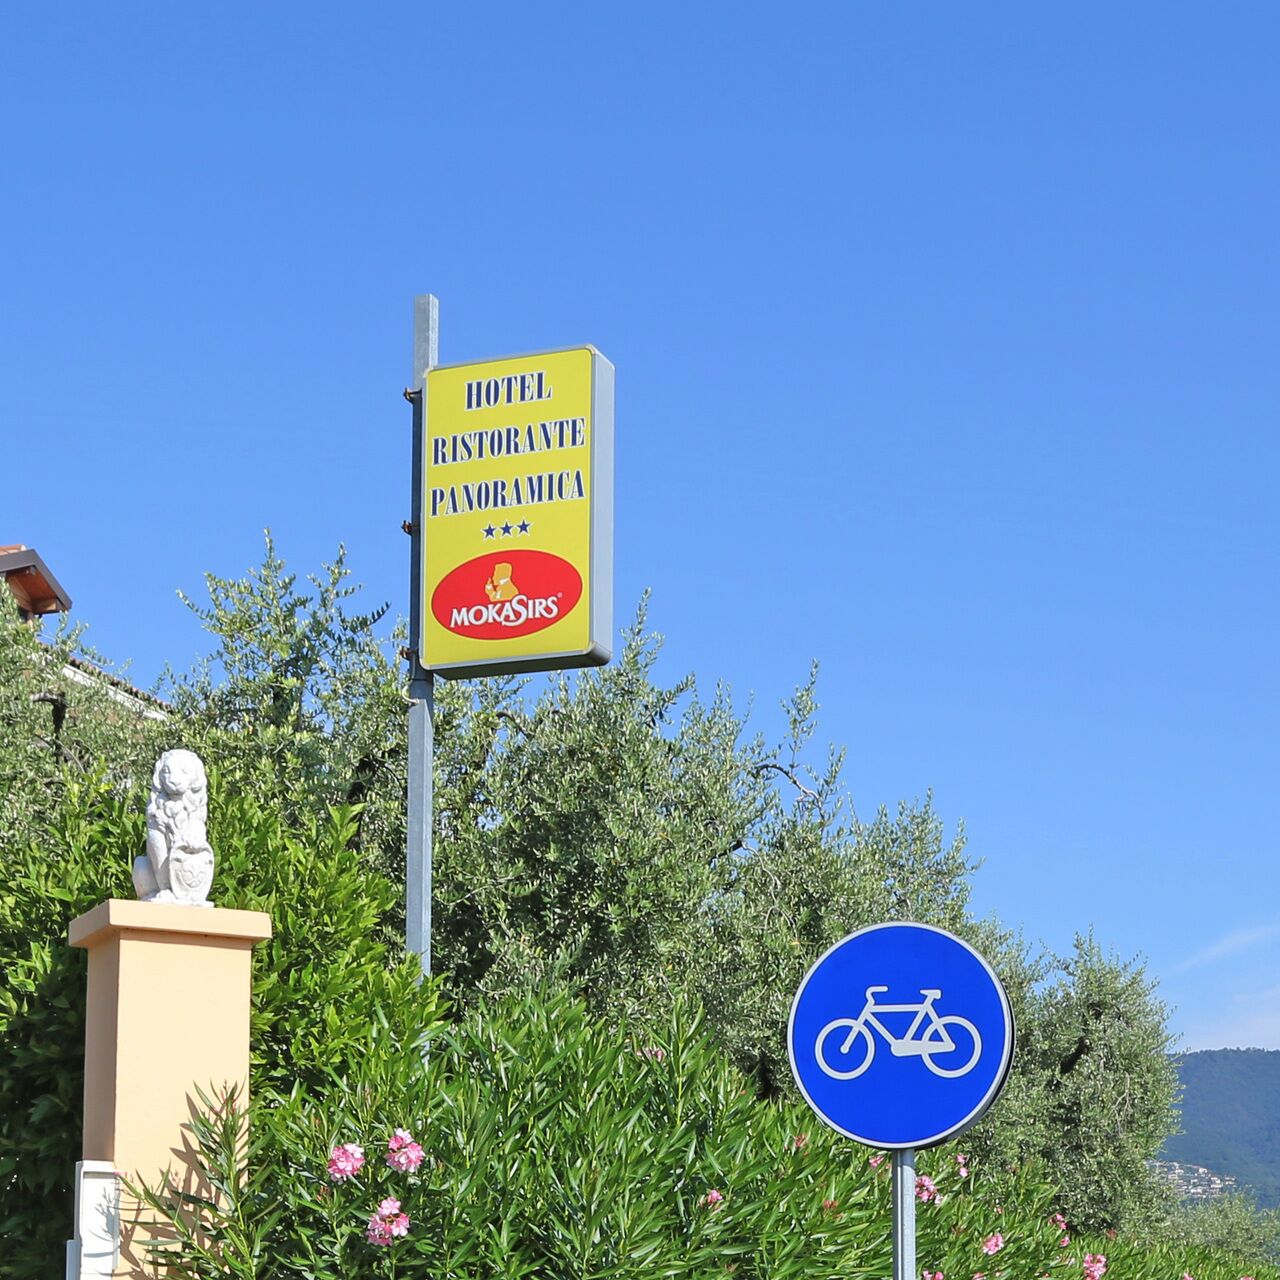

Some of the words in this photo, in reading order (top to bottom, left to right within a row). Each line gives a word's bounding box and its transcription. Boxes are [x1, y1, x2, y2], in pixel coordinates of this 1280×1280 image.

[465, 371, 552, 411] HOTEL
[432, 417, 585, 466] RISTORANTE
[430, 469, 585, 517] PANORAMICA
[450, 594, 559, 628] MOKASIRS
